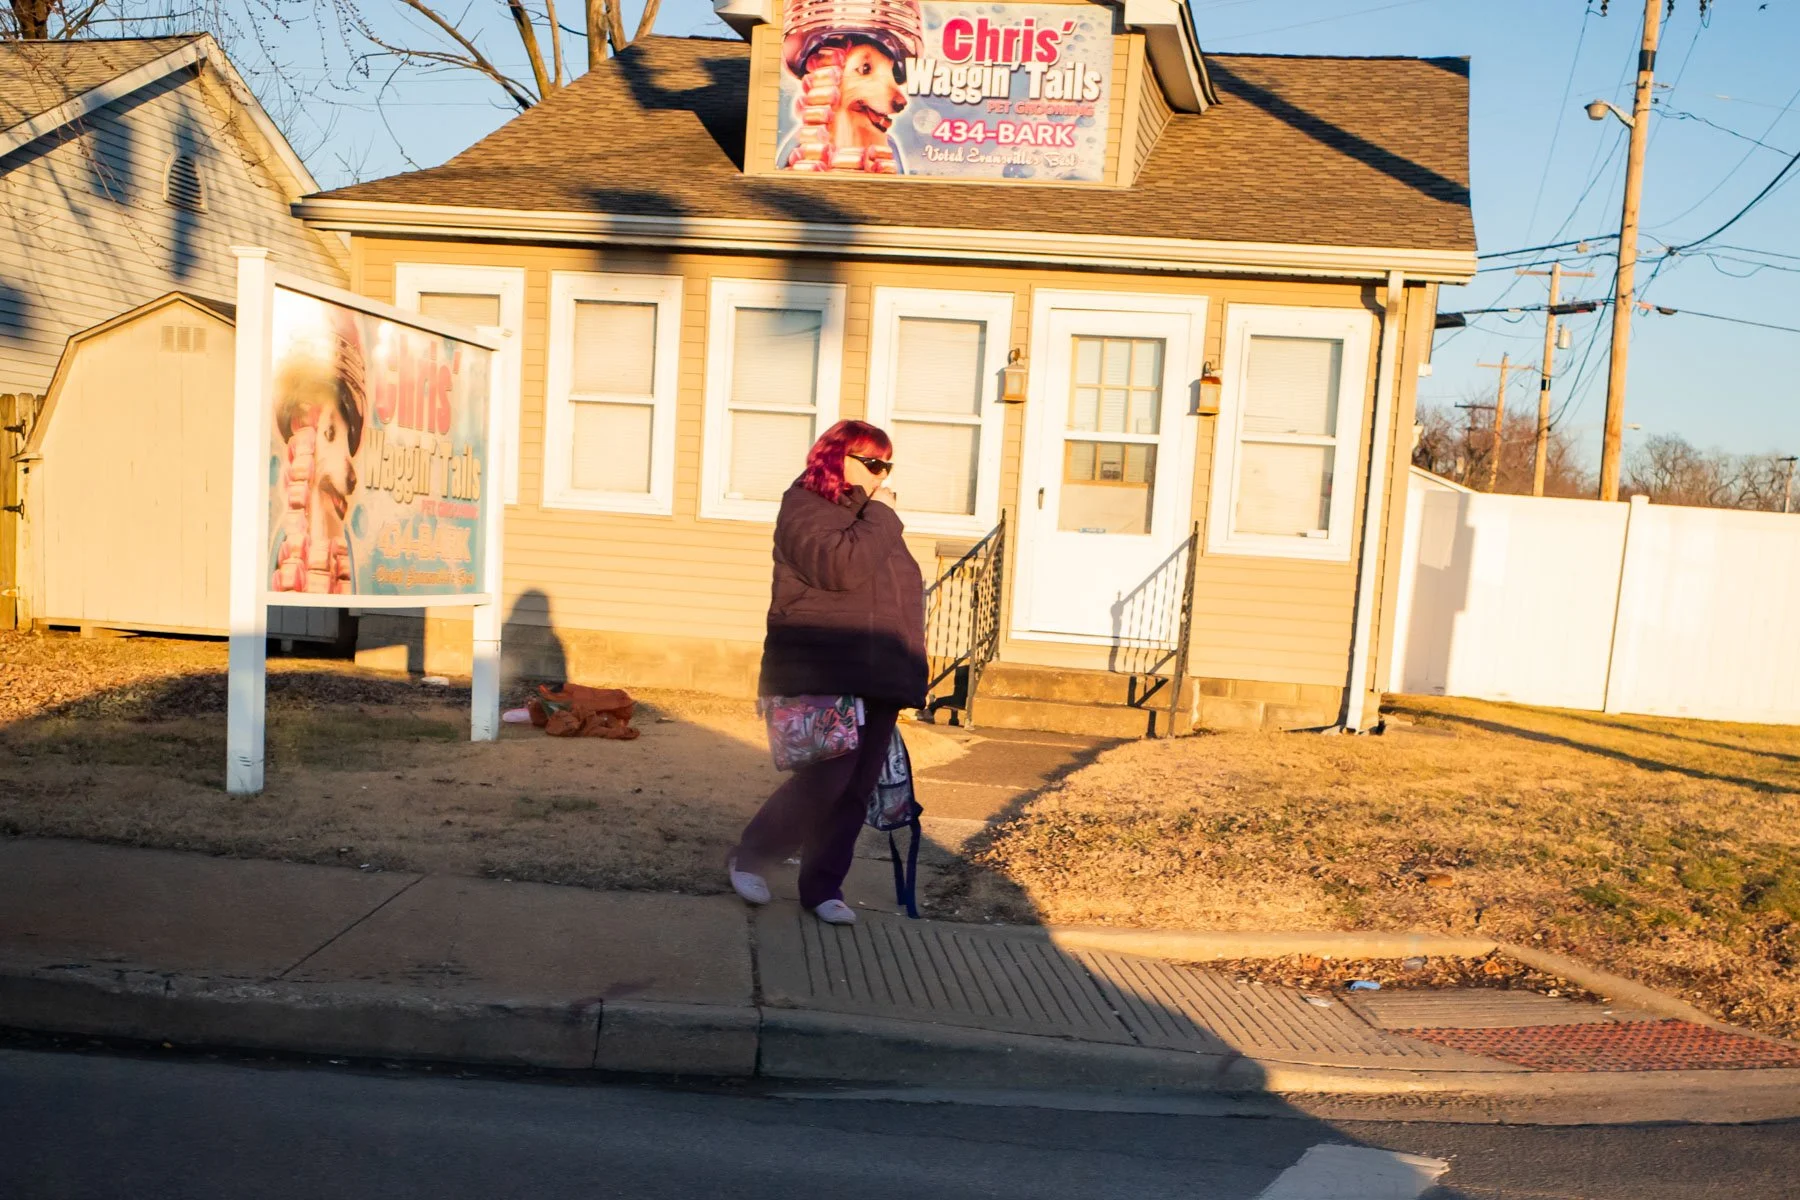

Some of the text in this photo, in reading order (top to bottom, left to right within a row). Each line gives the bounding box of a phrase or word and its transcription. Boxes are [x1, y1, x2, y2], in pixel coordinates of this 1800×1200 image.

[942, 17, 1076, 65] Chris'
[905, 57, 1102, 105] Waggin' Tails
[932, 119, 1076, 147] 434-BARK
[986, 101, 1096, 118] PET GROOMING
[375, 333, 461, 436] Chris'
[364, 427, 482, 505] Waggin' Tails
